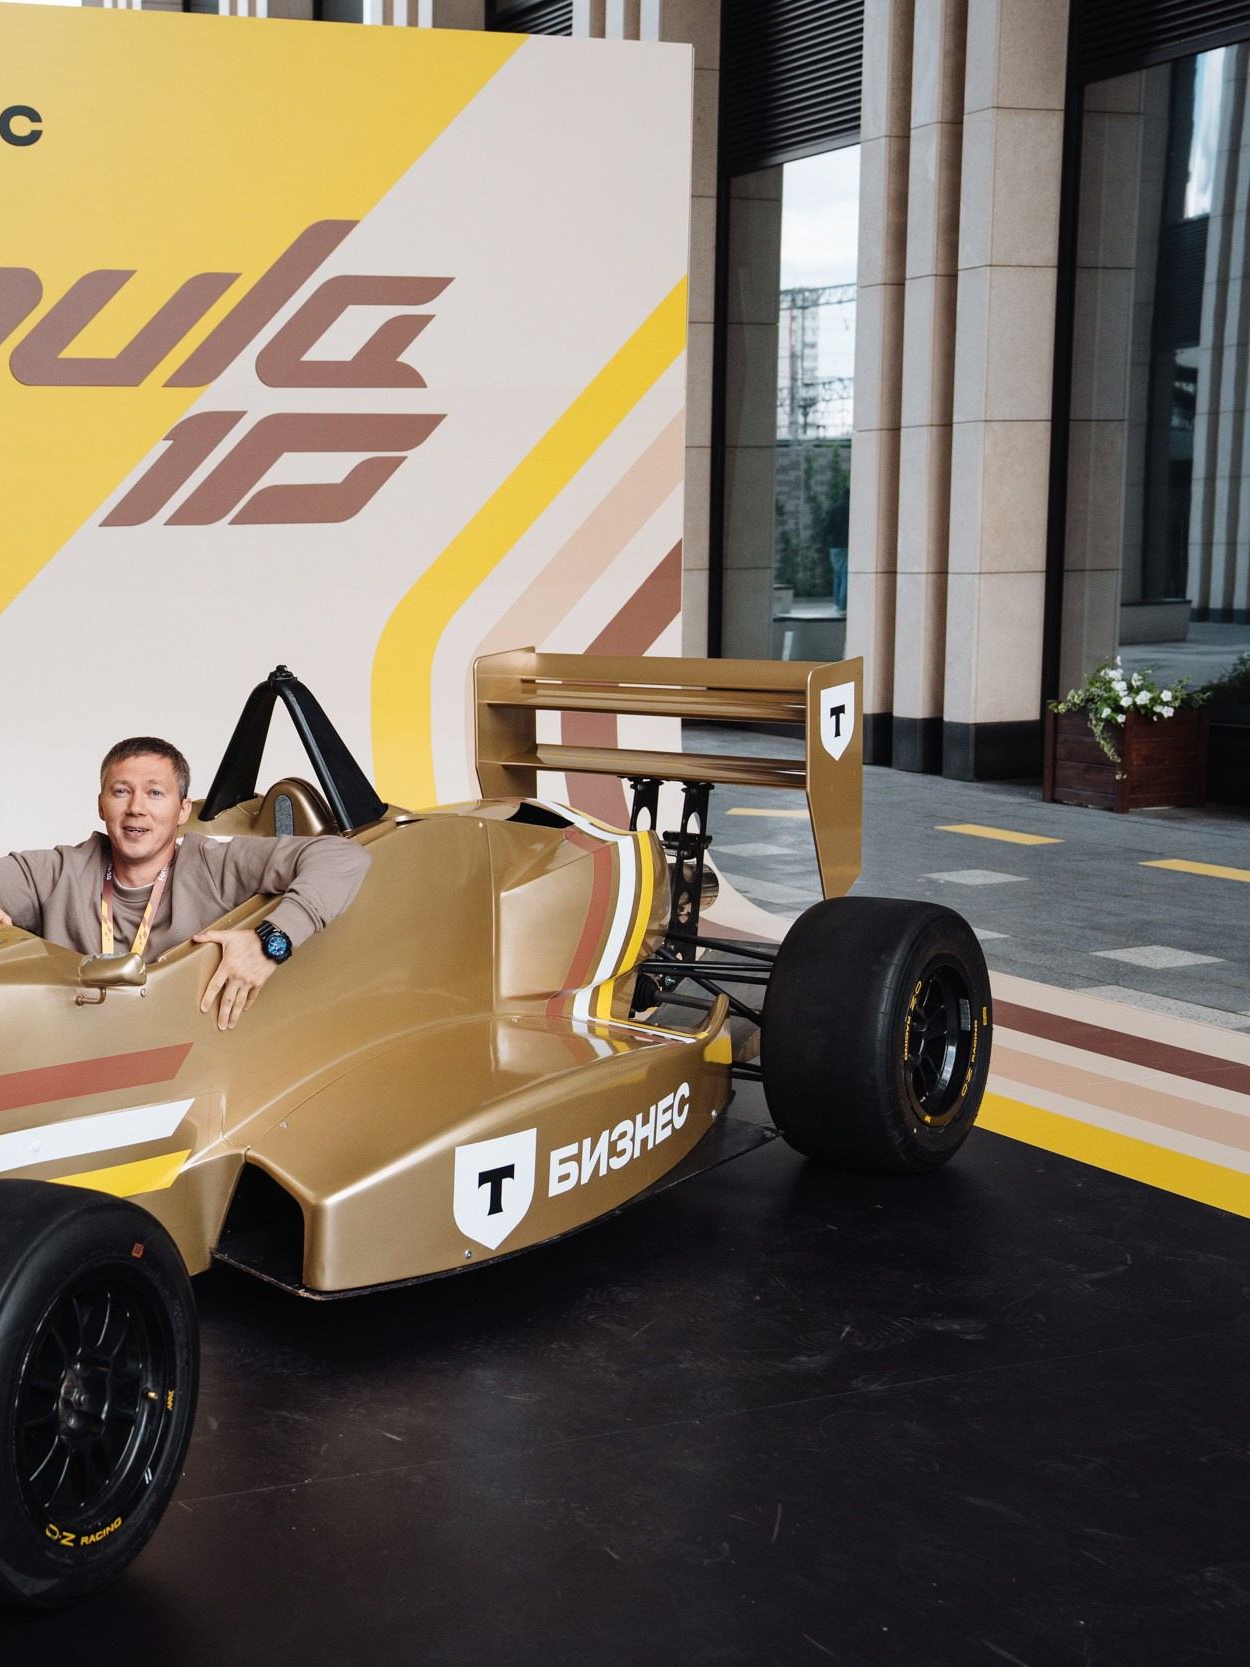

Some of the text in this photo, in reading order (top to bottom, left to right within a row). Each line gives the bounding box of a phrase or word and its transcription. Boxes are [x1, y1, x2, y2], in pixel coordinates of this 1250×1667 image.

[98, 410, 448, 527] 10
[548, 1081, 690, 1198] БИЗНЕС
[80, 1516, 122, 1545] RACING
